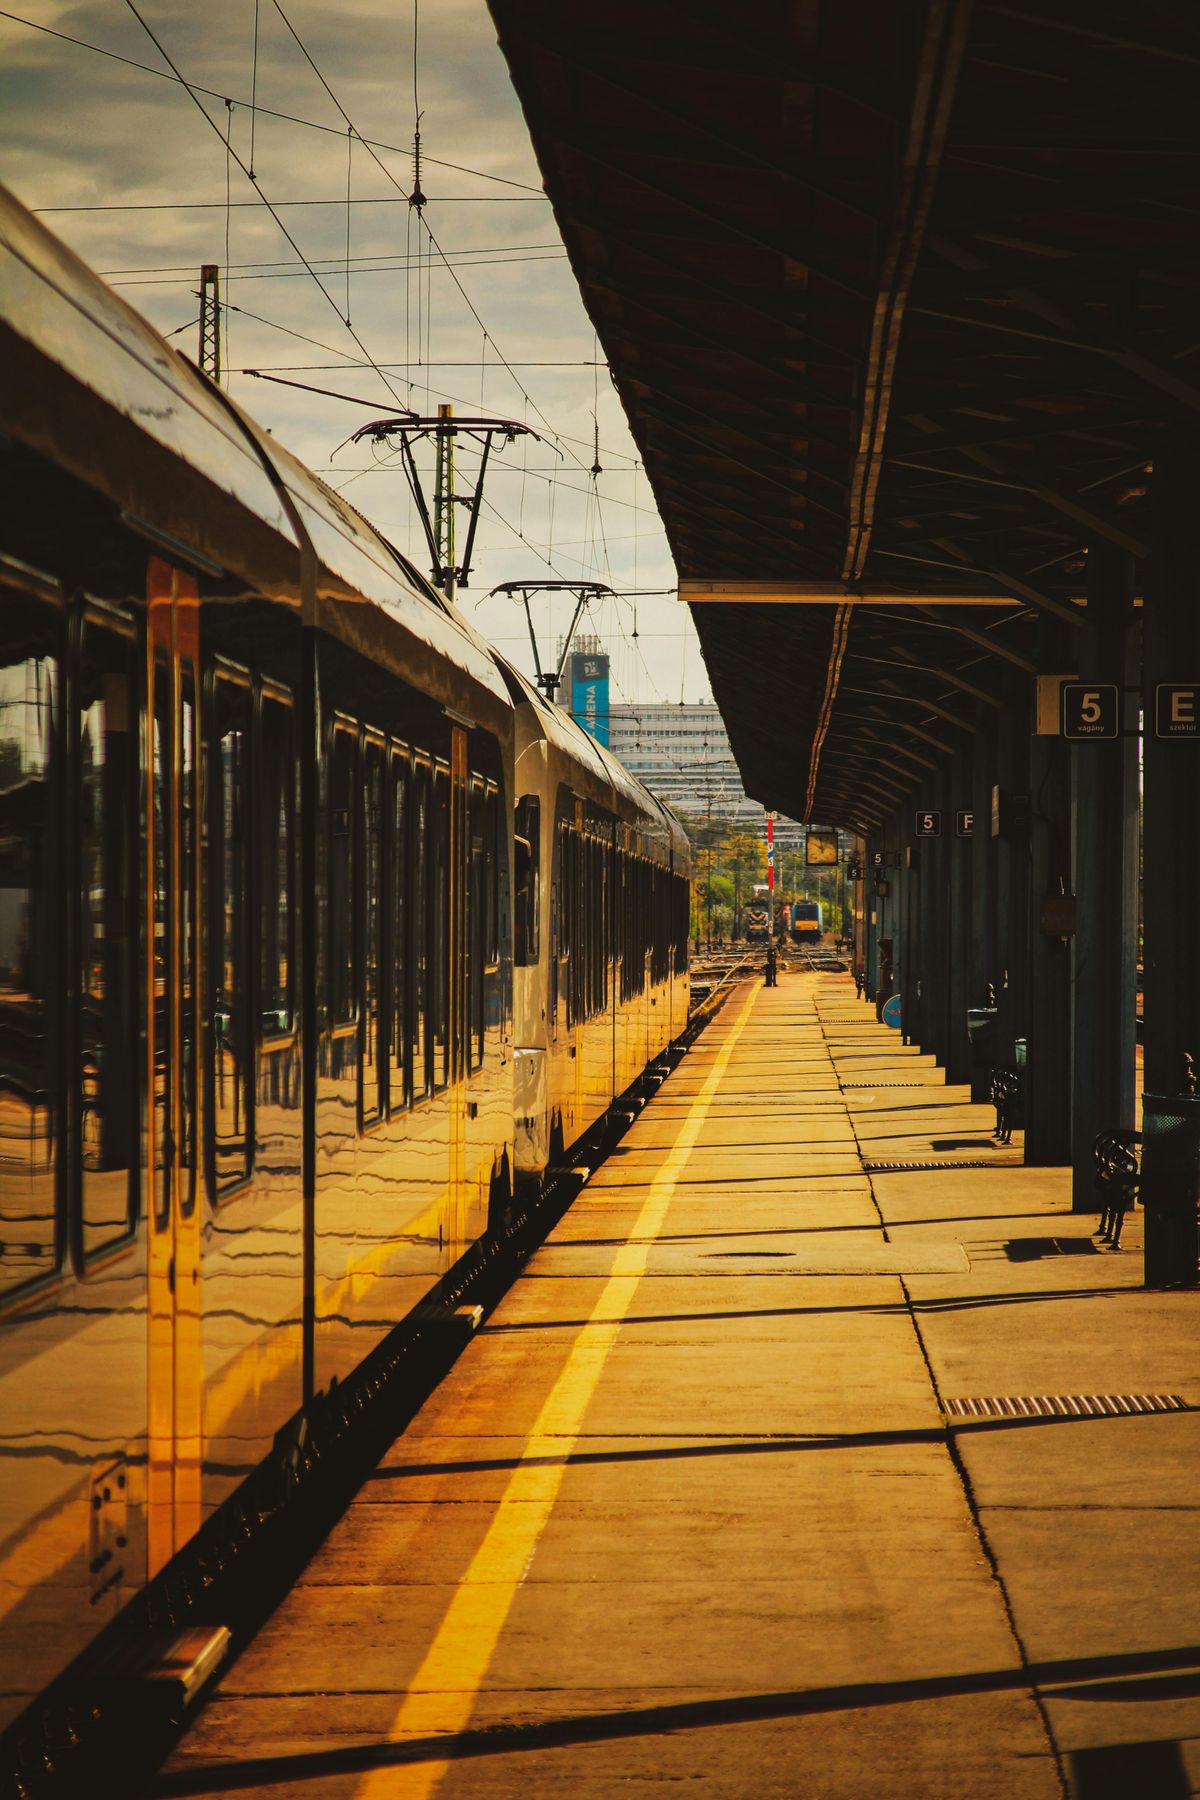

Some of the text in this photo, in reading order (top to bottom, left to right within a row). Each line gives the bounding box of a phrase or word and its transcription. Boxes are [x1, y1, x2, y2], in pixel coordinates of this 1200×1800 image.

[586, 685, 596, 729] ARENA
[1081, 693, 1101, 722] 5
[1172, 692, 1195, 722] E
[1077, 724, 1105, 733] vágány
[923, 815, 933, 829] 5
[964, 815, 973, 829] F
[875, 853, 882, 863] 5
[851, 869, 857, 877] 5
